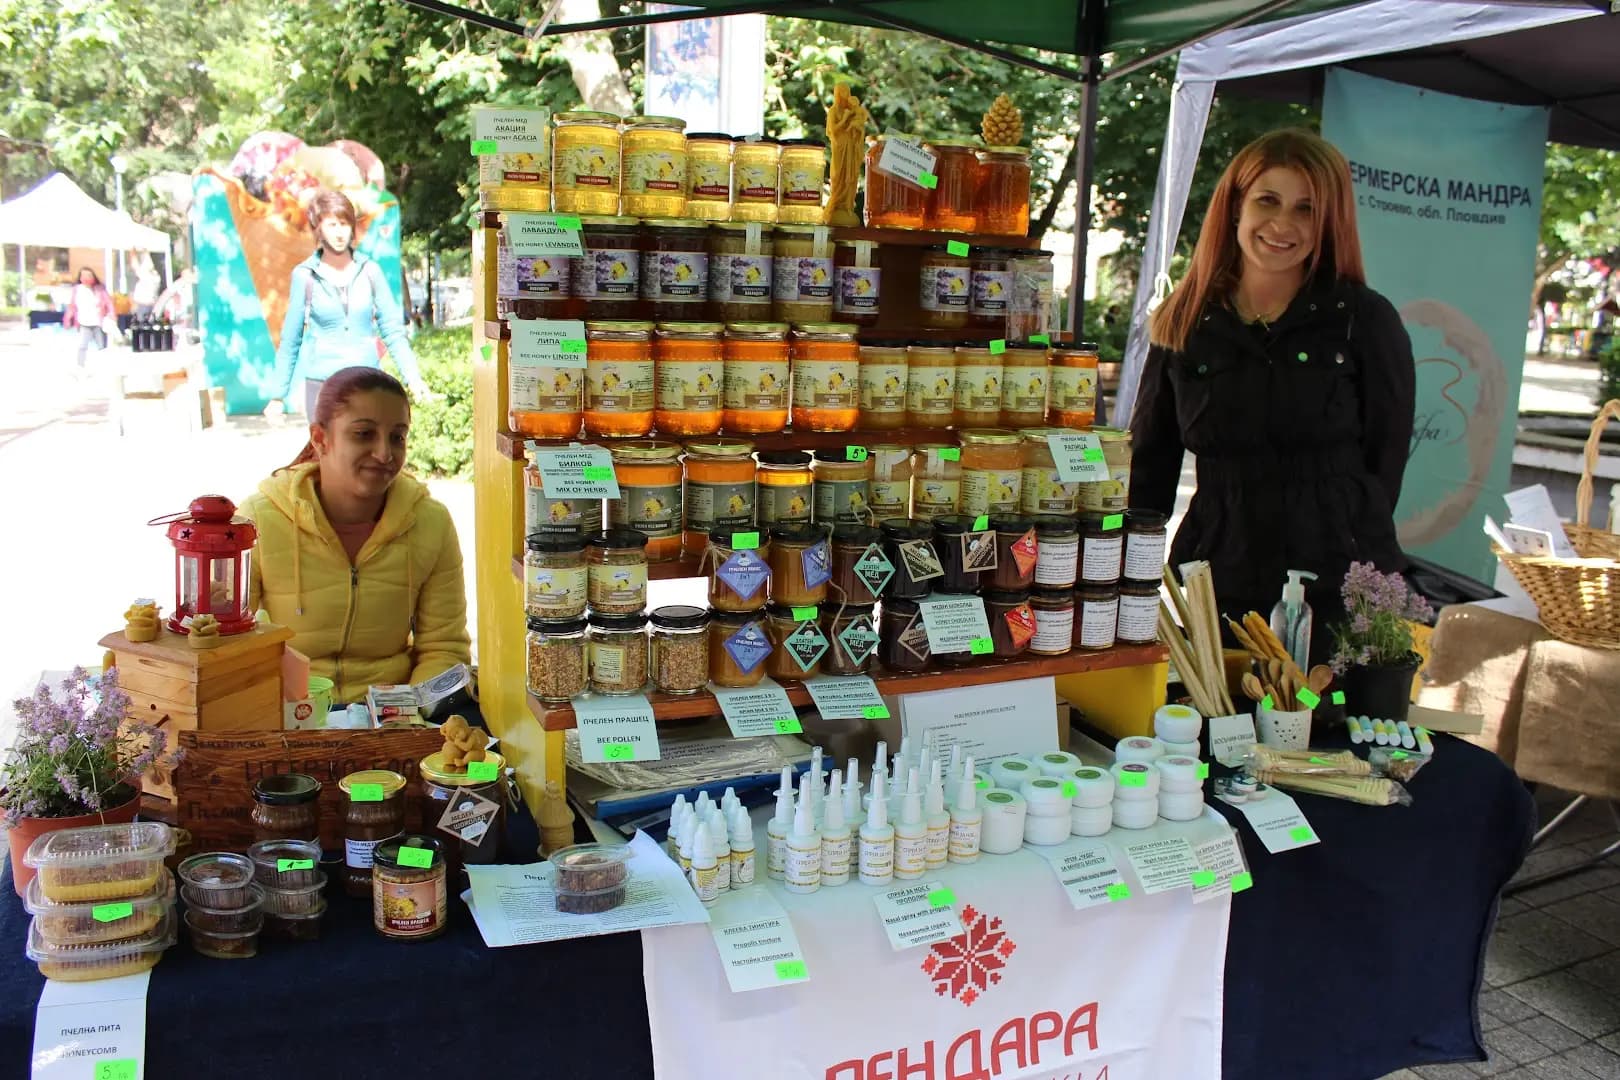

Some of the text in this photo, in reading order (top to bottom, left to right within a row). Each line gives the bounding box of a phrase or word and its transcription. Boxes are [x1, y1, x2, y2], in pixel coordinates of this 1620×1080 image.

[495, 125, 526, 134] АКАЦИЯ
[513, 134, 538, 142] ACACIA
[1348, 161, 1533, 209] ЕРМЕРСКА МАНДРА
[1446, 207, 1507, 226] Пловдив
[558, 461, 593, 469] БИЛКОВ
[864, 570, 880, 579] МЕД
[849, 639, 865, 648] МЕД
[796, 645, 813, 653] МЕД
[583, 716, 650, 725] ПЧЕЛЕН ПРАШЕЦ
[612, 735, 641, 743] POLLEN
[451, 810, 474, 822] МЕДЕН
[885, 916, 901, 925] Nasal
[901, 912, 916, 922] spray
[916, 910, 929, 918] with
[748, 920, 781, 932] ТИНКТУРА
[733, 939, 759, 950] Propolis
[61, 1022, 122, 1038] ПЧЕЛНА ПИТА
